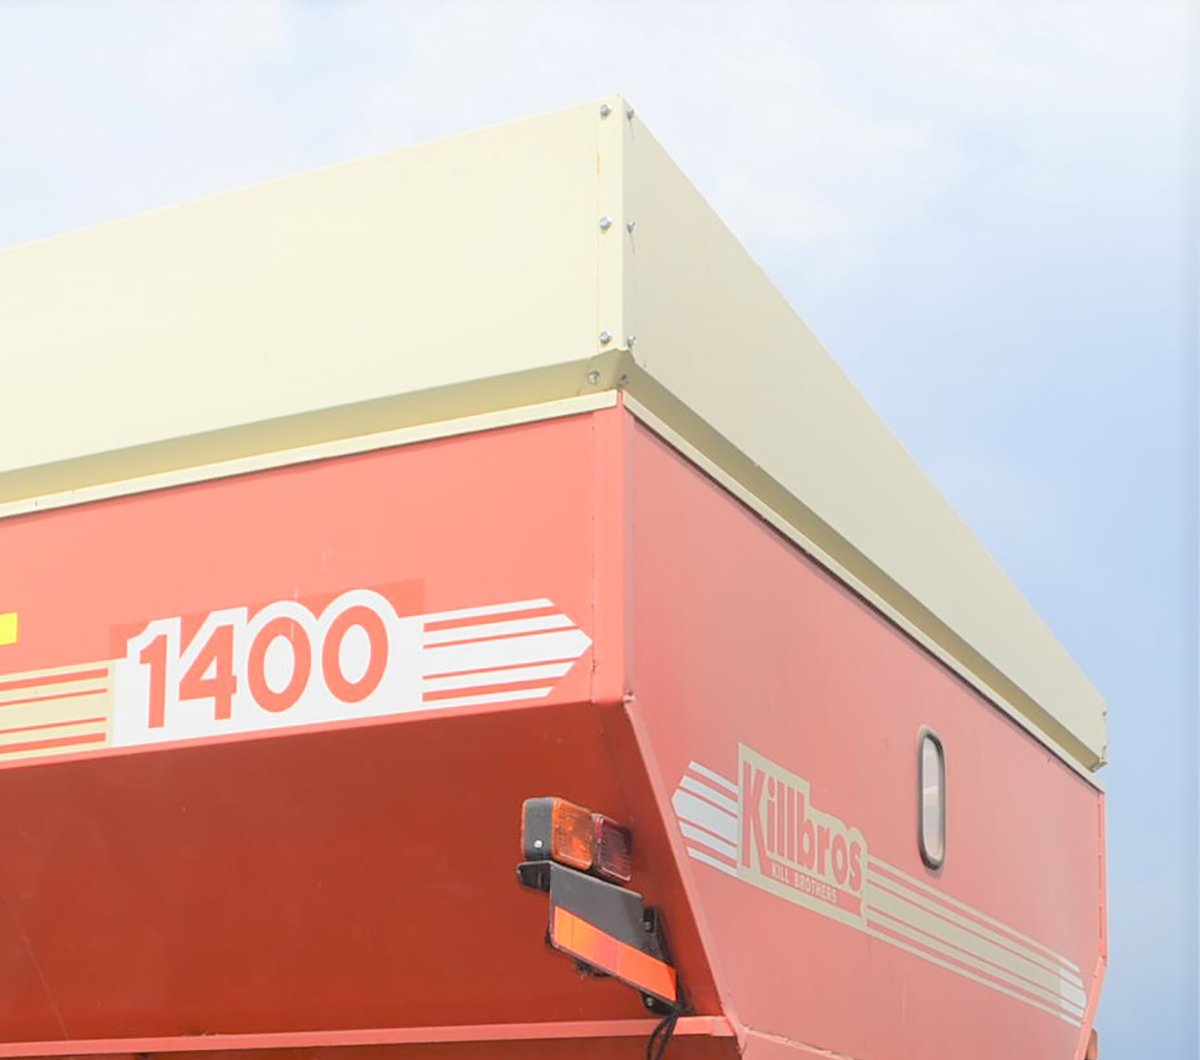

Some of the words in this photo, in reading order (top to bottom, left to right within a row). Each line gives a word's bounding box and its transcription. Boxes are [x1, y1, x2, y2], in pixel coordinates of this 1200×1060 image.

[140, 604, 389, 729] 1400
[742, 760, 863, 893] Killbros
[771, 862, 790, 884] KILL
[794, 872, 838, 904] BROTHERS
